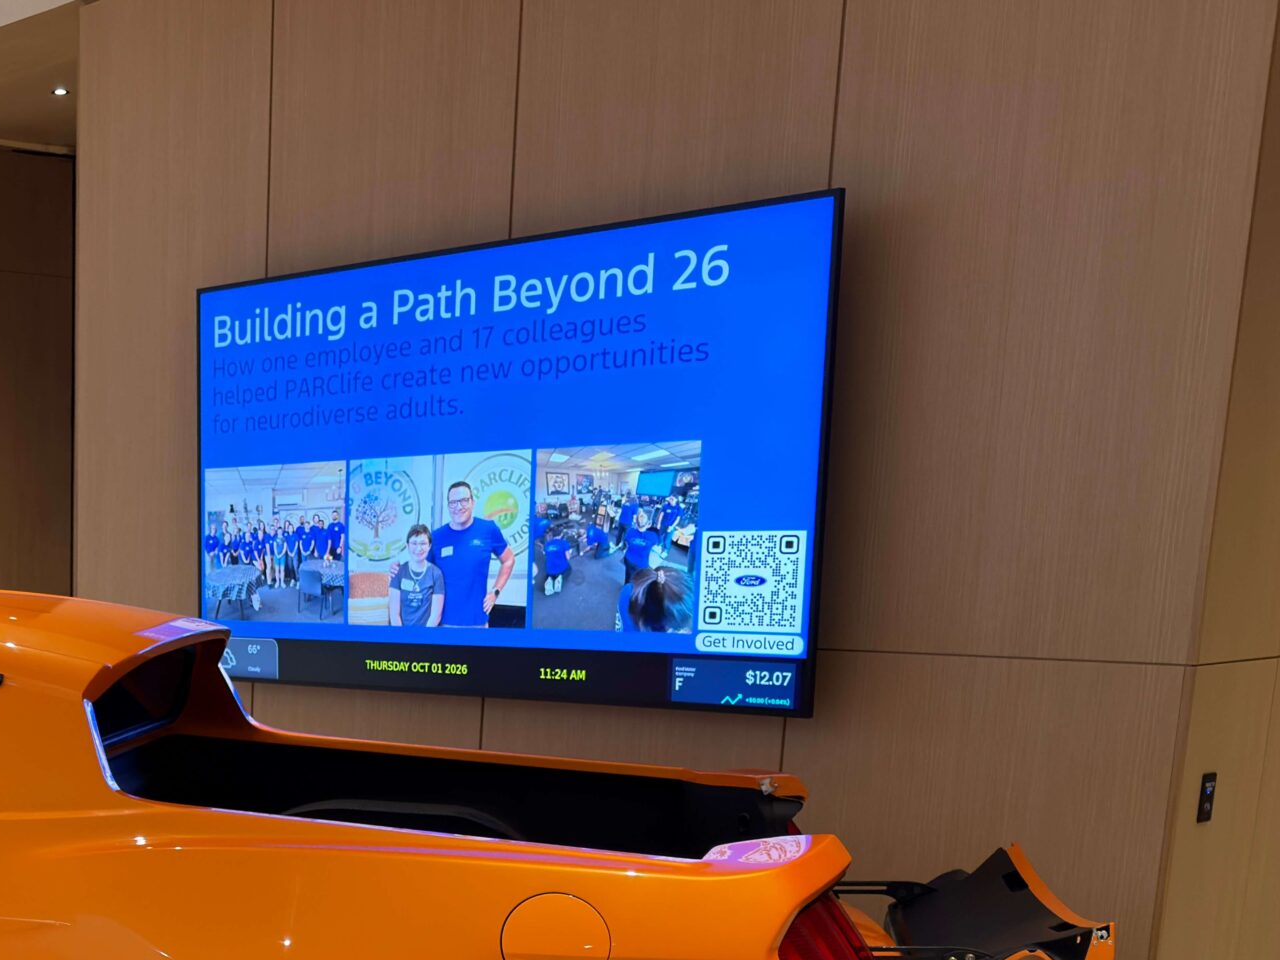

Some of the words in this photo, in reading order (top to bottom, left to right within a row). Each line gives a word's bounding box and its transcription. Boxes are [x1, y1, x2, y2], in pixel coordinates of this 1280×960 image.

[213, 302, 347, 349] Building
[359, 300, 378, 329] a
[392, 279, 476, 325] Path
[493, 252, 655, 315] Beyond
[672, 244, 730, 291] 26
[212, 358, 256, 380] How
[261, 352, 297, 374] one
[304, 340, 412, 369] employee
[420, 329, 463, 356] and
[472, 325, 495, 349] 17
[502, 313, 647, 346] colleagues
[212, 380, 278, 409] helped
[284, 370, 374, 400] PARClife
[380, 364, 452, 391] create
[461, 360, 513, 383] new
[520, 338, 710, 381] opportunities
[212, 414, 239, 435] for
[244, 402, 379, 433] neurodiverse
[385, 394, 465, 421] adults.
[363, 471, 414, 515] BEYOND
[702, 635, 727, 648] Get
[732, 636, 795, 651] Involved
[365, 659, 410, 672] THURSDAY
[411, 662, 430, 673] OCT
[431, 663, 443, 674] 01
[444, 663, 468, 675] 2026
[539, 667, 568, 680] 11:24
[569, 669, 587, 681] AM
[745, 669, 792, 687] $12.07
[675, 677, 684, 691] F
